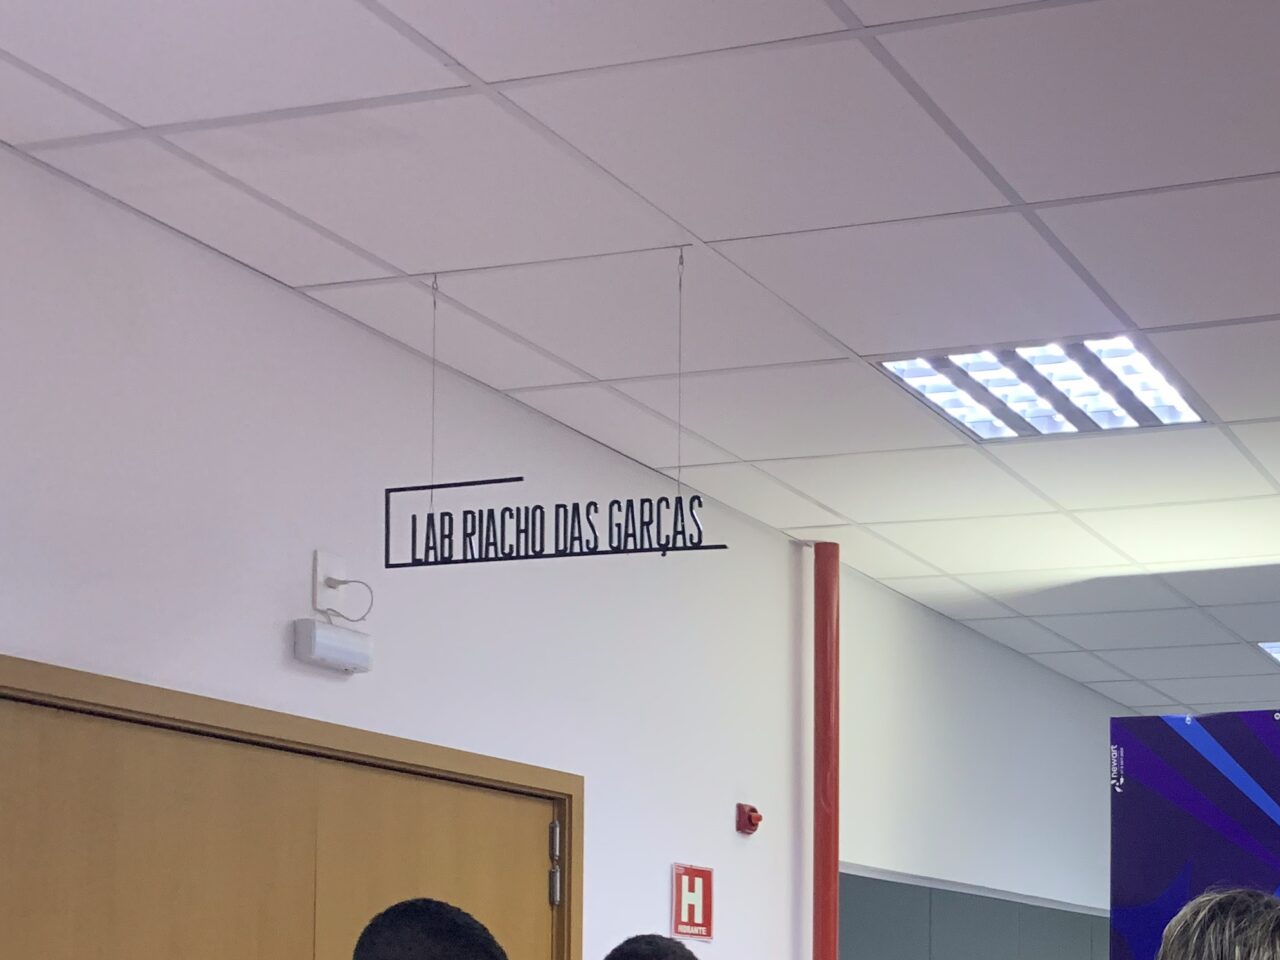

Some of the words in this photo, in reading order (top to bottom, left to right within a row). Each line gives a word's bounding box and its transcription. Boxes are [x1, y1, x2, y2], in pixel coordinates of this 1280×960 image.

[411, 511, 454, 564] LAB
[462, 505, 546, 561] RIACHO
[554, 501, 600, 554] DAS
[608, 495, 704, 557] GARÇAS
[681, 875, 703, 924] H
